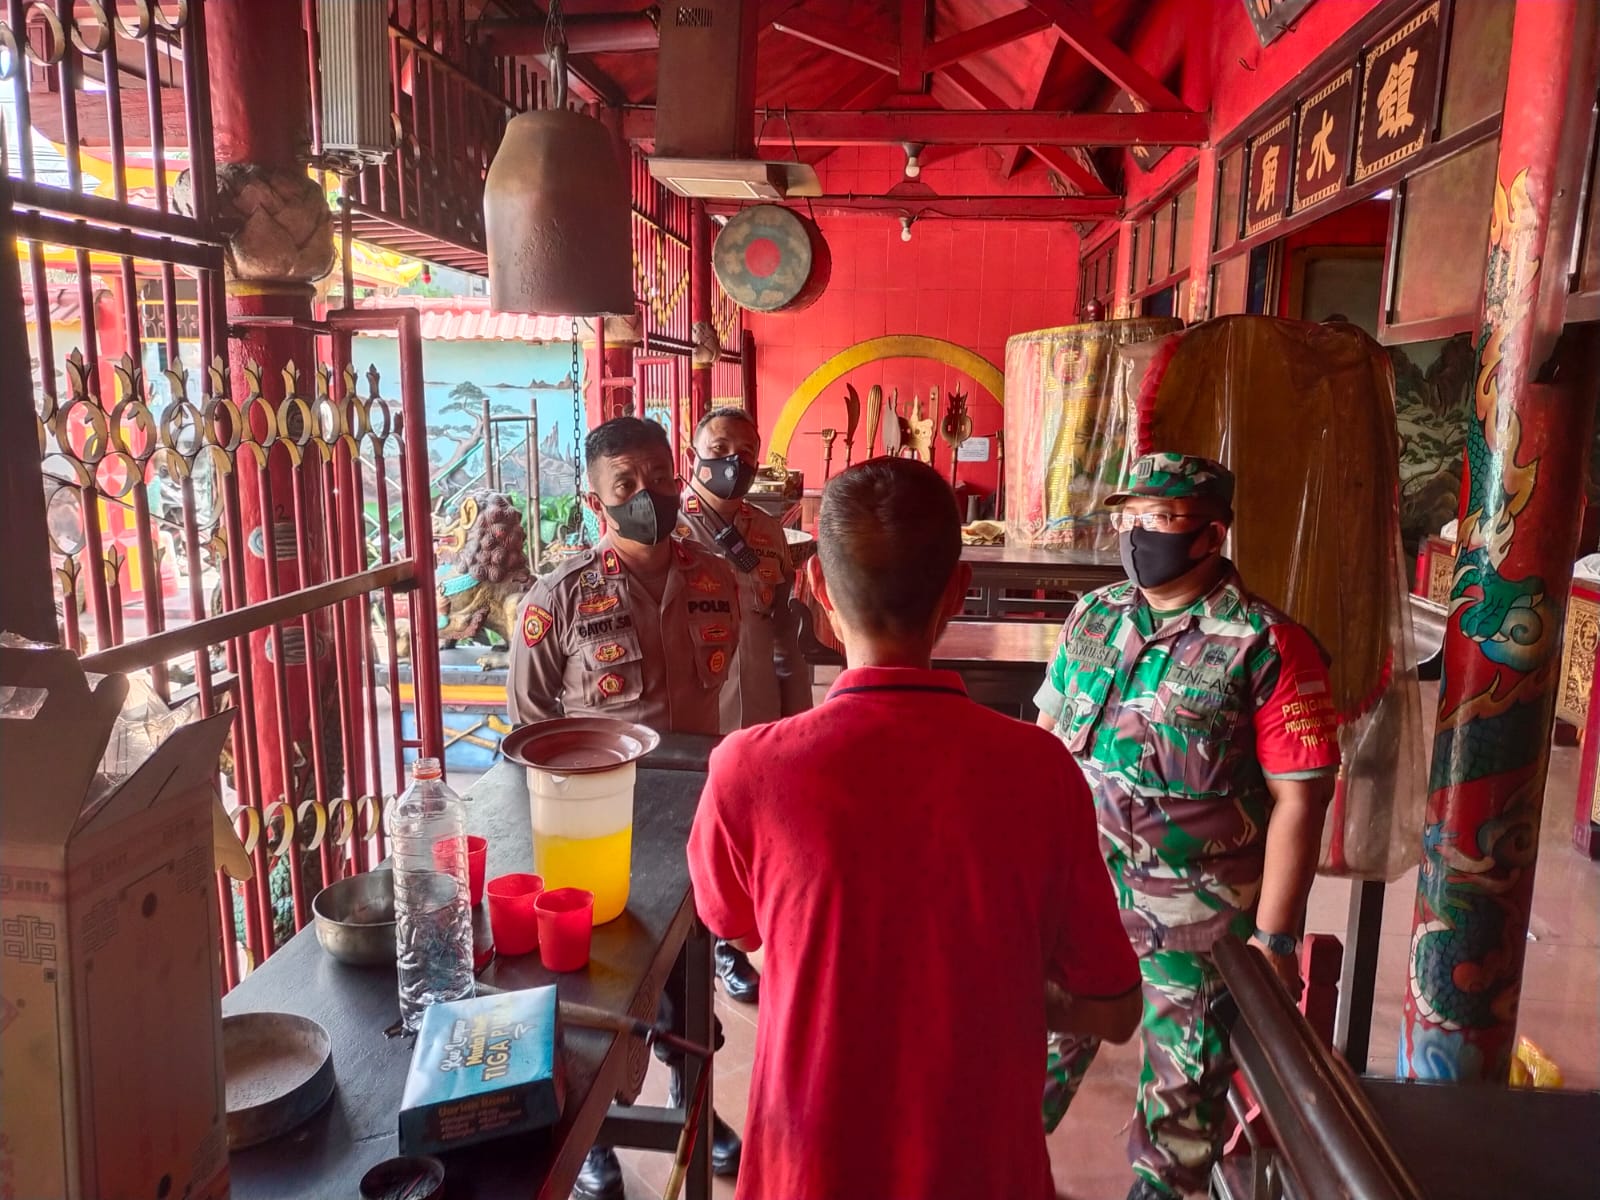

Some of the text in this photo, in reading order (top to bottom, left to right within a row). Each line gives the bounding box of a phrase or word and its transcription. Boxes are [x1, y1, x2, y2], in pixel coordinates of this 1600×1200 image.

[579, 619, 613, 638] GATOT
[1177, 666, 1239, 695] TNI-AD
[484, 1039, 511, 1081] TIGA
